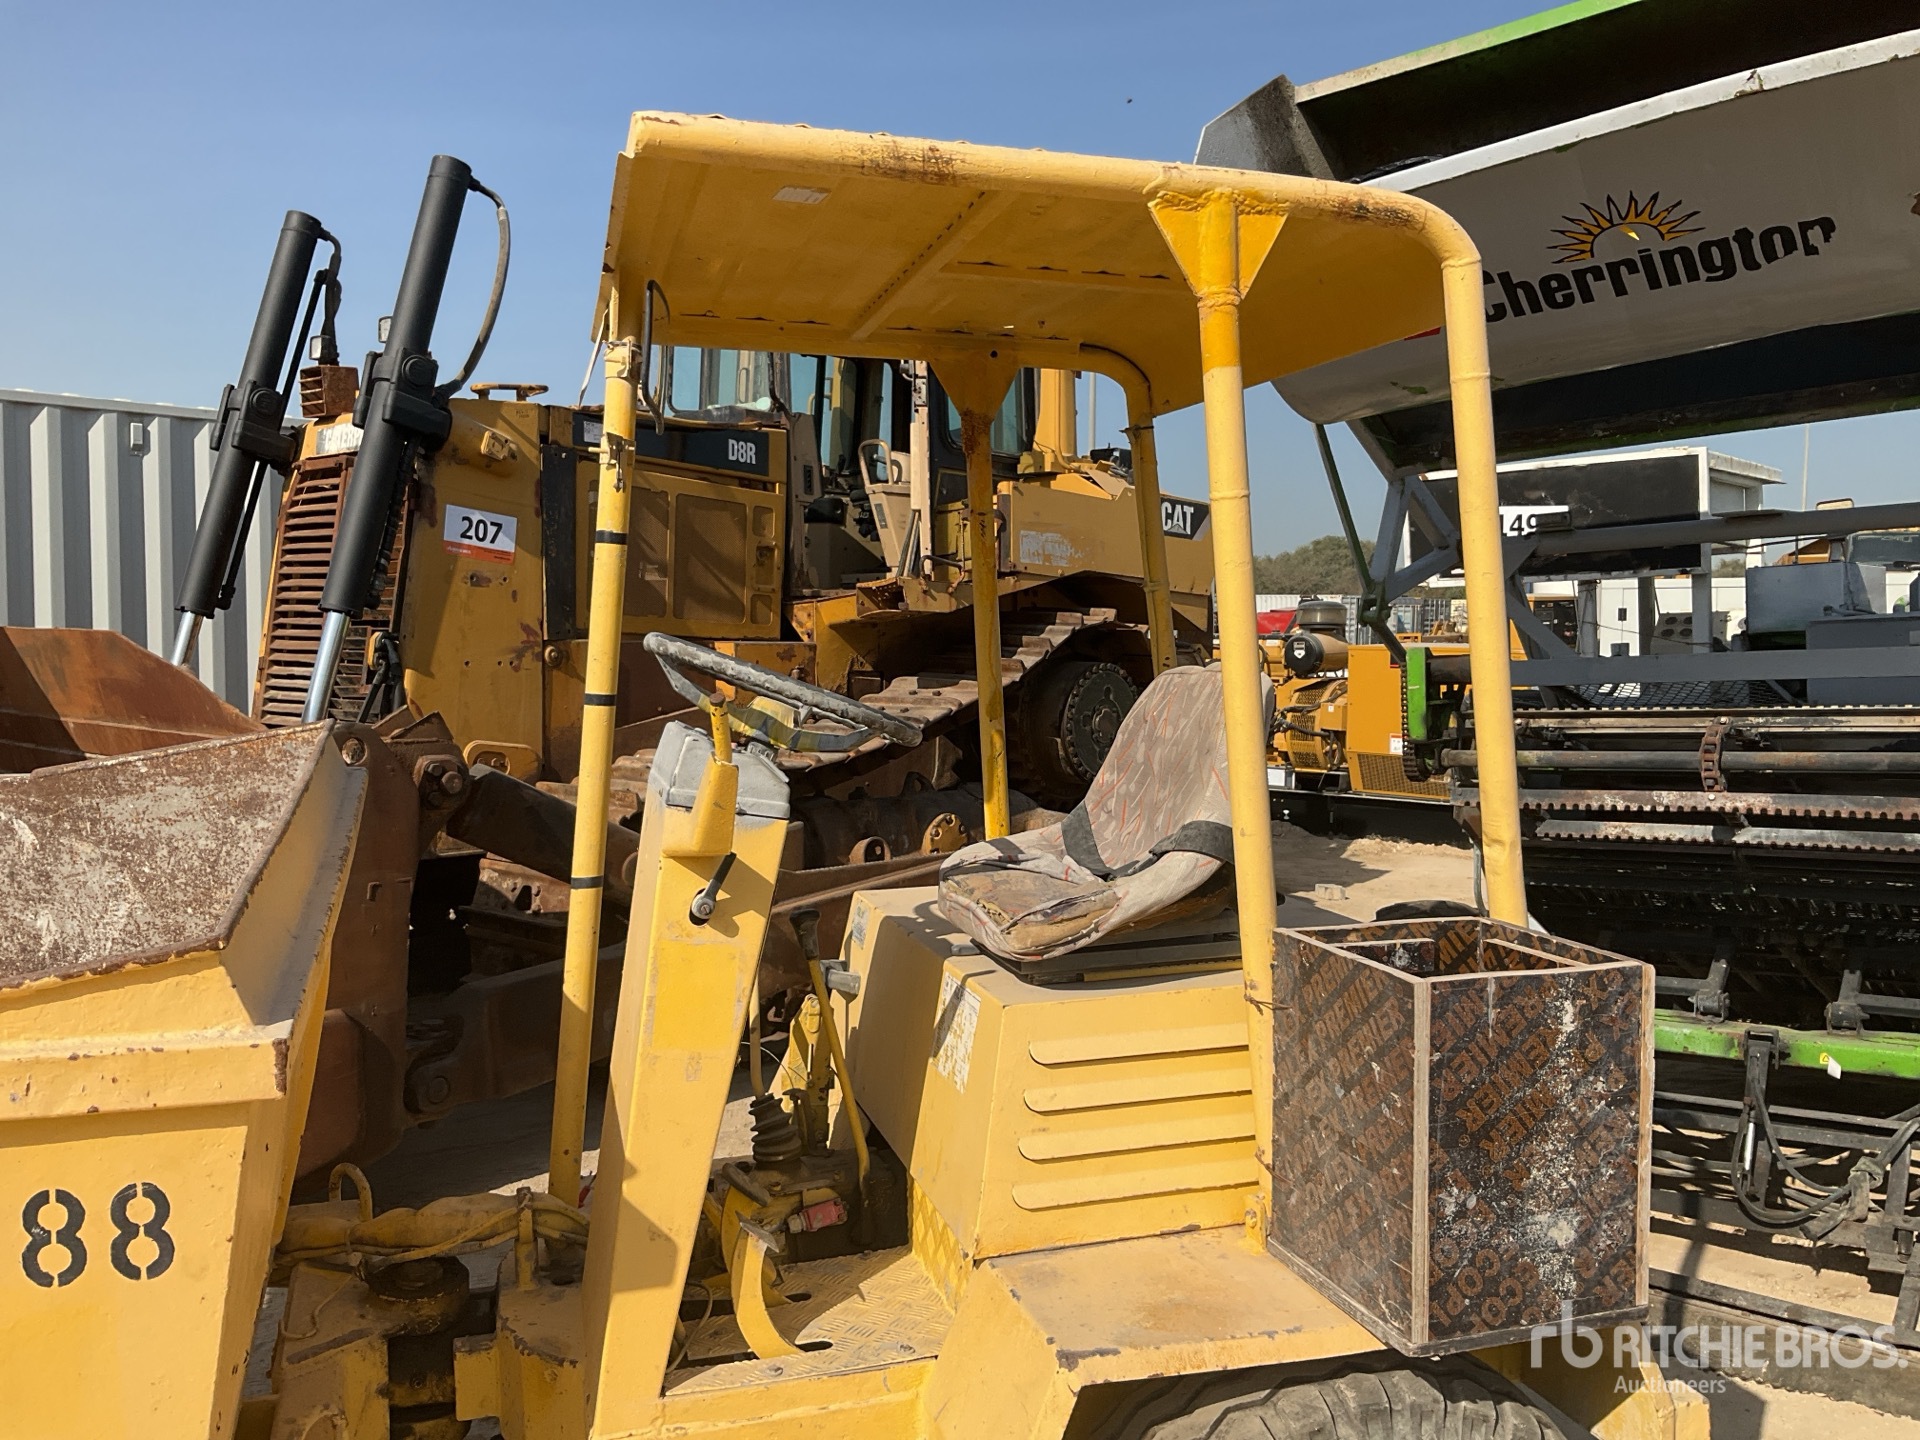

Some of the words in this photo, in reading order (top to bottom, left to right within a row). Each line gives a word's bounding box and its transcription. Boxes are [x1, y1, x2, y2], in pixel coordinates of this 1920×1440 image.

[728, 439, 756, 464] D8R
[460, 515, 503, 544] 207
[1162, 501, 1194, 535] CAT
[22, 1182, 175, 1288] 88
